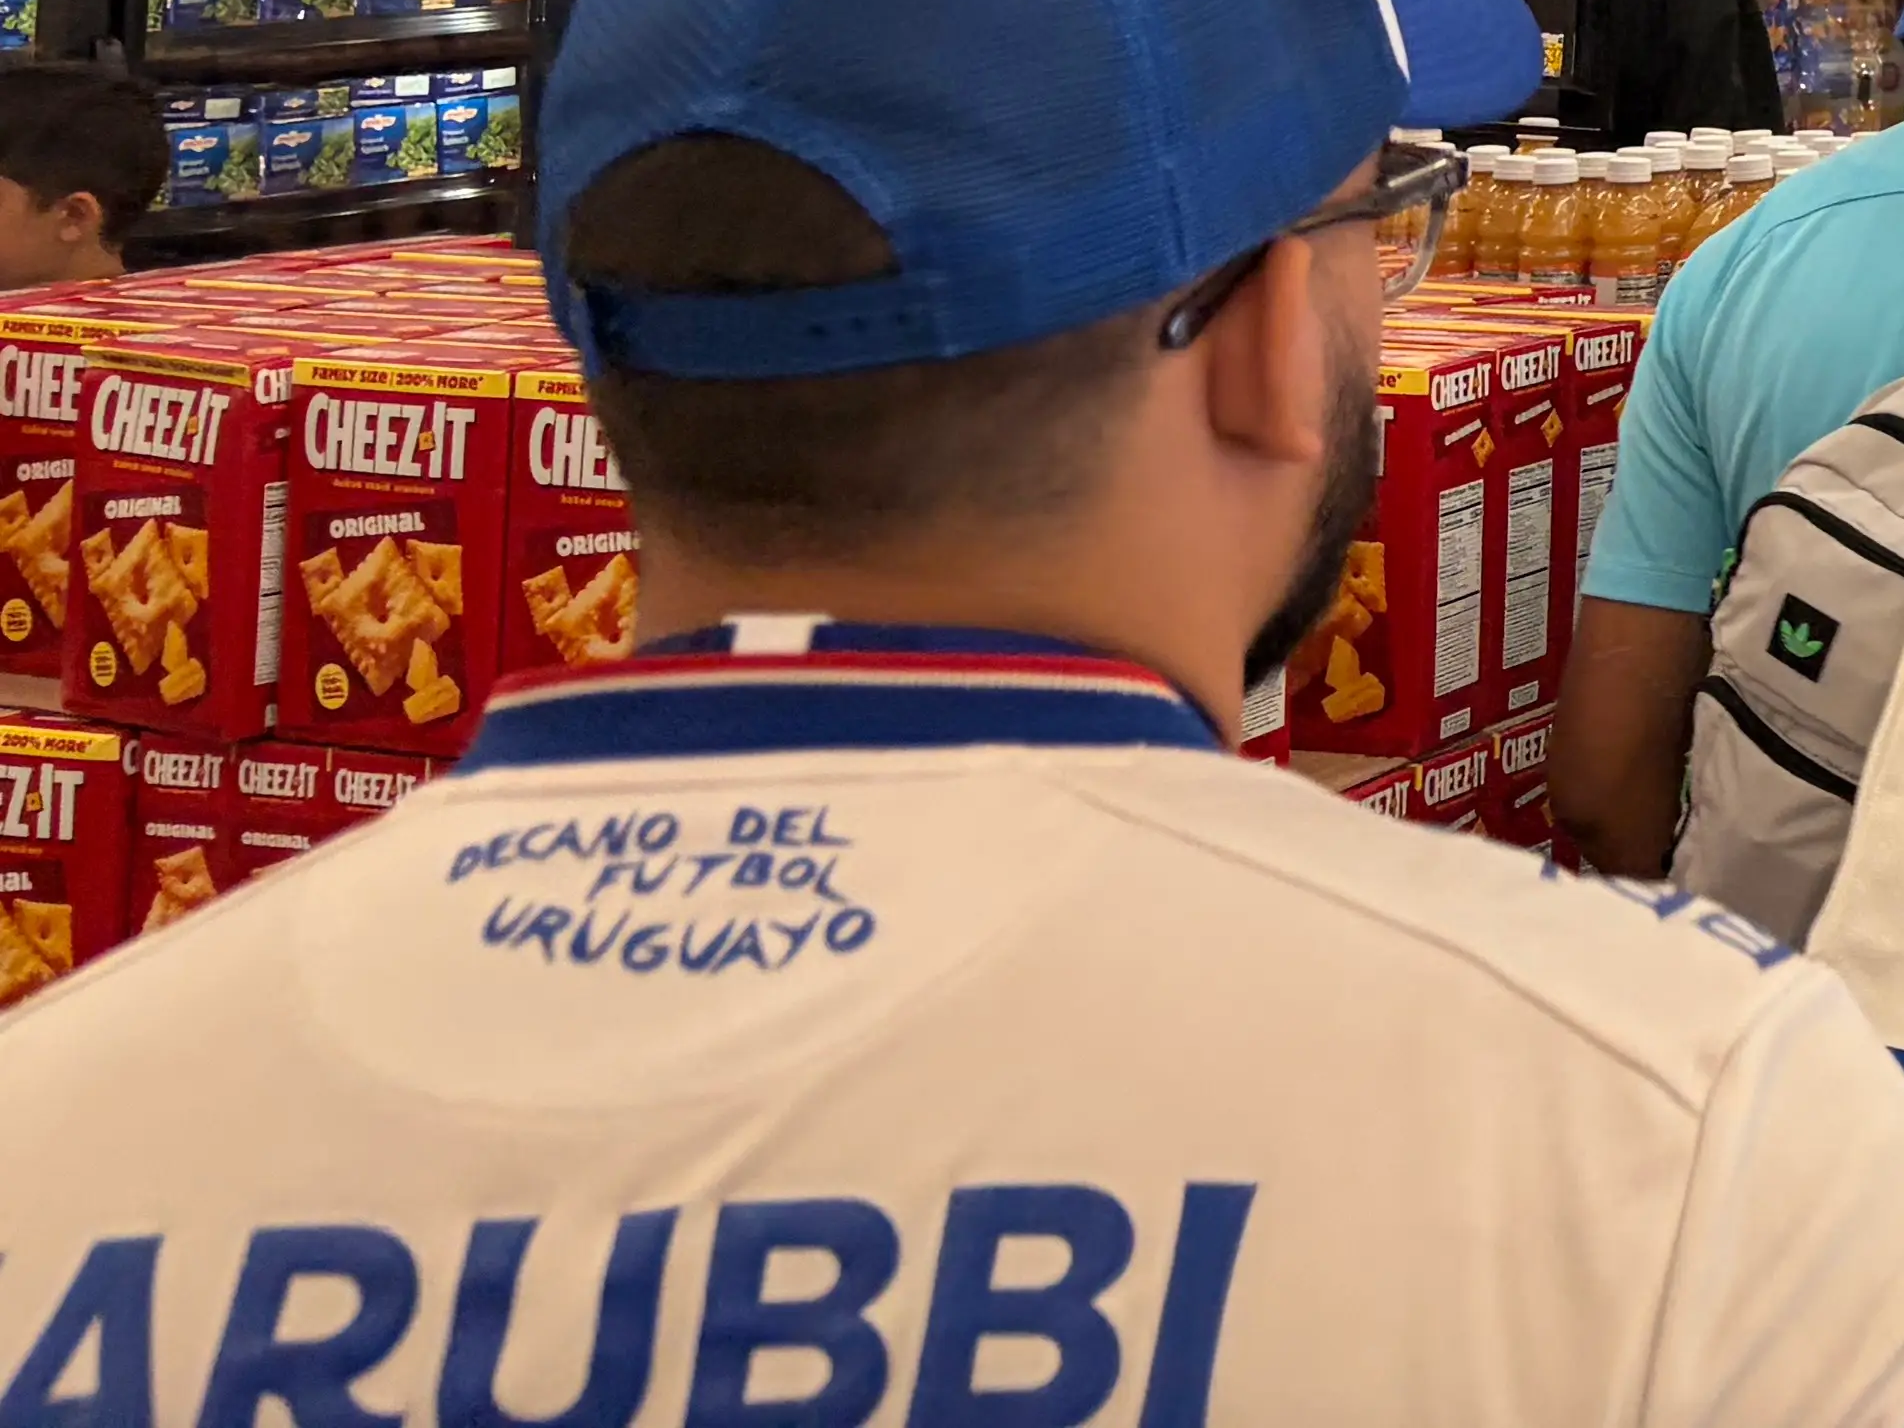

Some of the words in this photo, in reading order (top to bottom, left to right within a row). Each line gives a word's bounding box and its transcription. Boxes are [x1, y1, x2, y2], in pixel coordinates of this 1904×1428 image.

[395, 370, 435, 388] 200%
[445, 810, 680, 886] DECANO
[727, 802, 854, 848] DEL
[586, 851, 848, 904] FUTBOL
[481, 895, 876, 974] URUGUAYO
[0, 1177, 1261, 1428] ARUBBI
